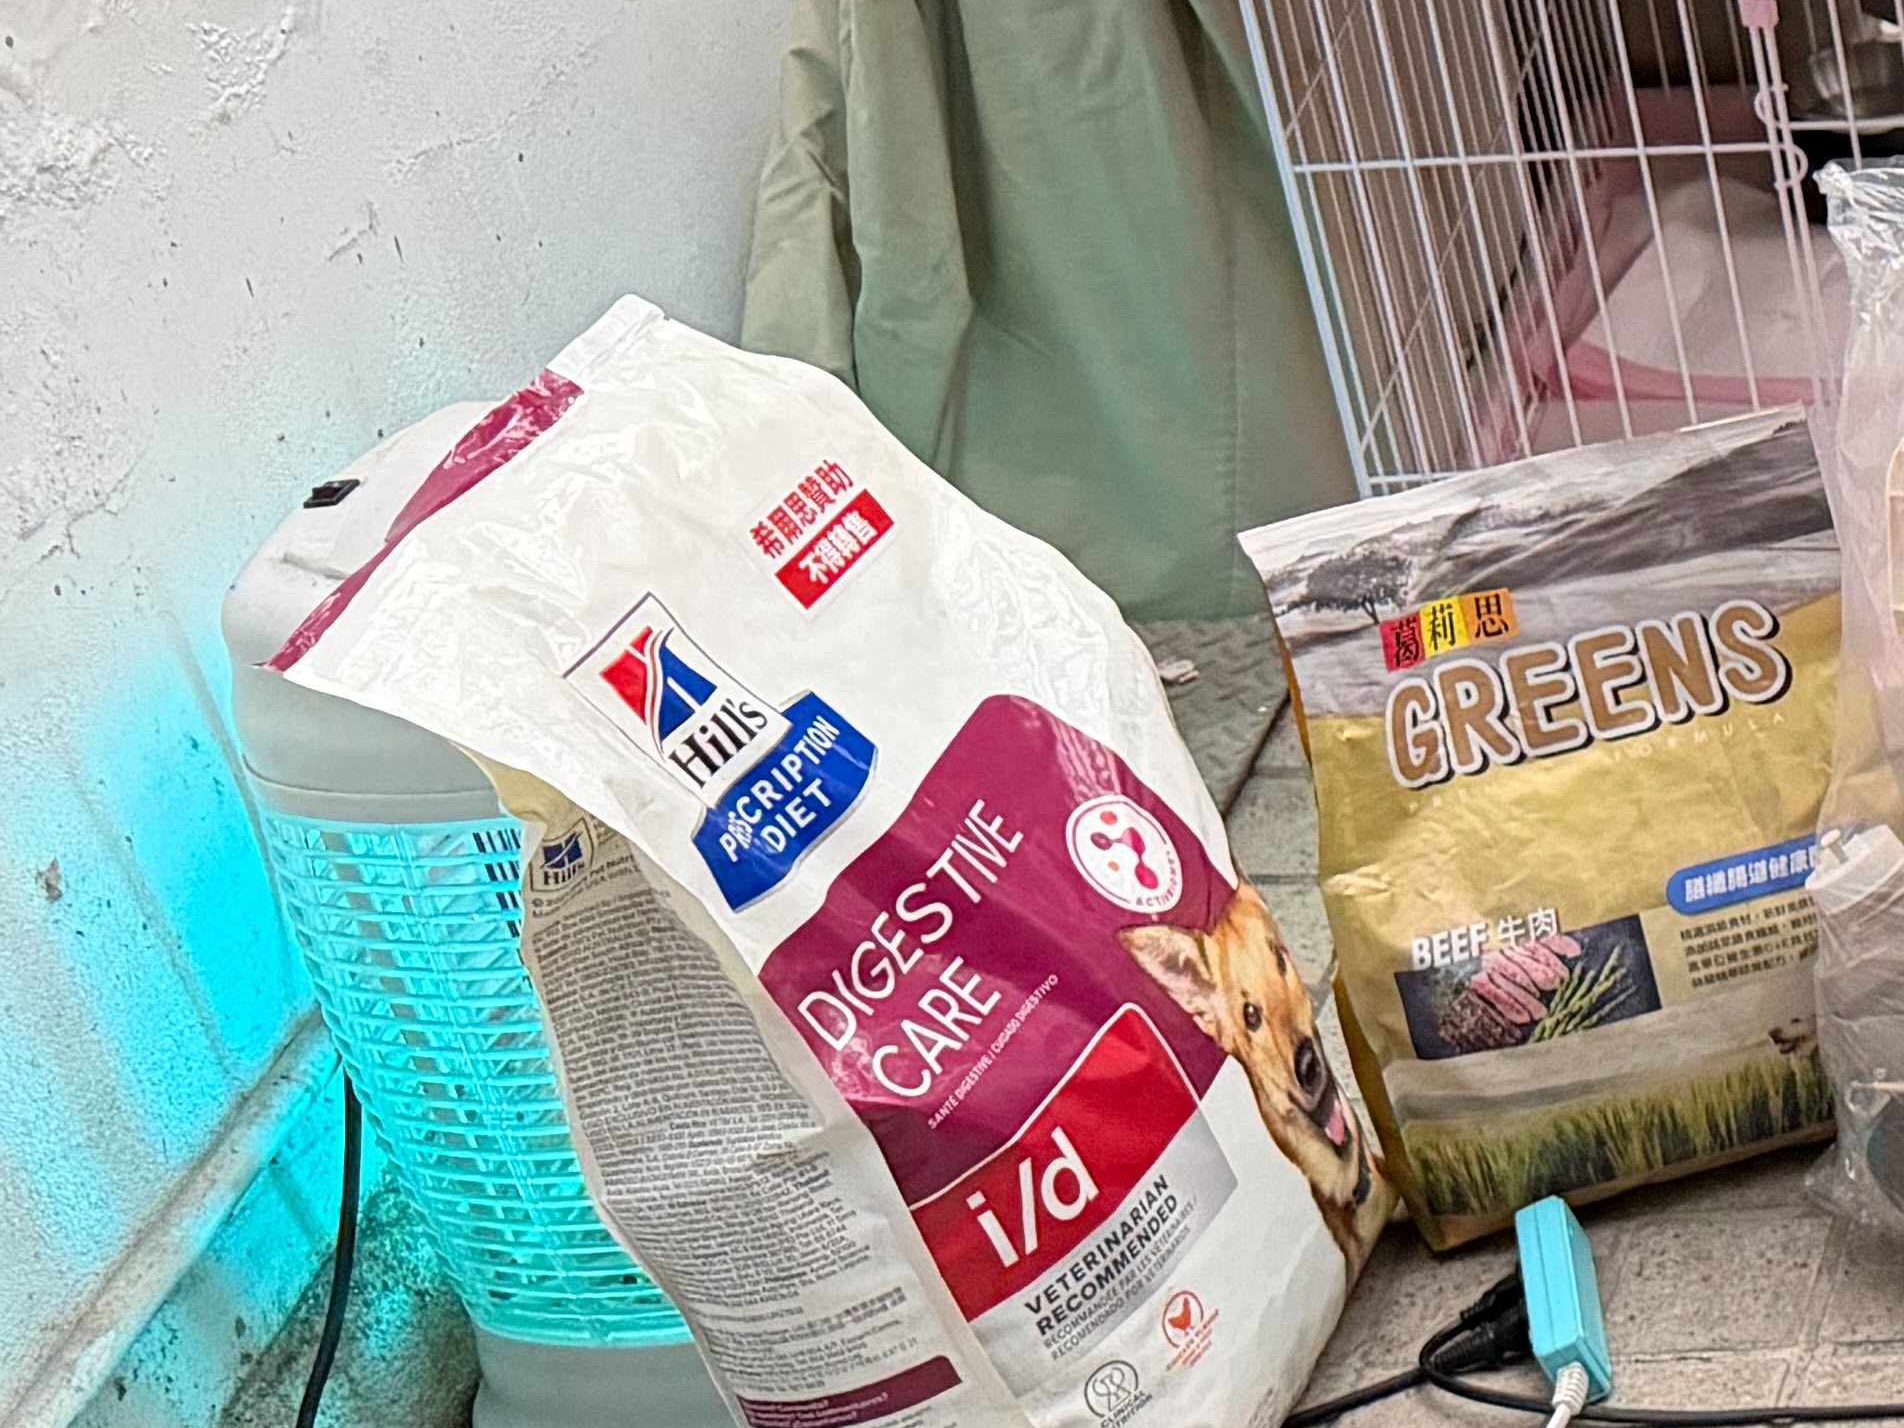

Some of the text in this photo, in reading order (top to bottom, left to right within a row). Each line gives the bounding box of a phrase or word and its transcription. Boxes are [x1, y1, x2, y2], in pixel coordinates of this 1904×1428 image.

[798, 509, 878, 585] 不得轉售
[1393, 593, 1510, 668] 葛莉思
[668, 698, 769, 789] Hill's
[1385, 599, 1793, 789] GREENS
[761, 778, 831, 853] DIET
[797, 799, 1024, 1051] DIGESTIVE
[1411, 906, 1559, 971] BEEF 牛肉
[872, 956, 1001, 1097] CARE
[1014, 974, 1059, 1022] DIGESTIVO
[966, 1127, 1100, 1268] i/d
[1024, 1175, 1168, 1314] VETERINARIAN
[1036, 1194, 1177, 1336] RECOMMENDED
